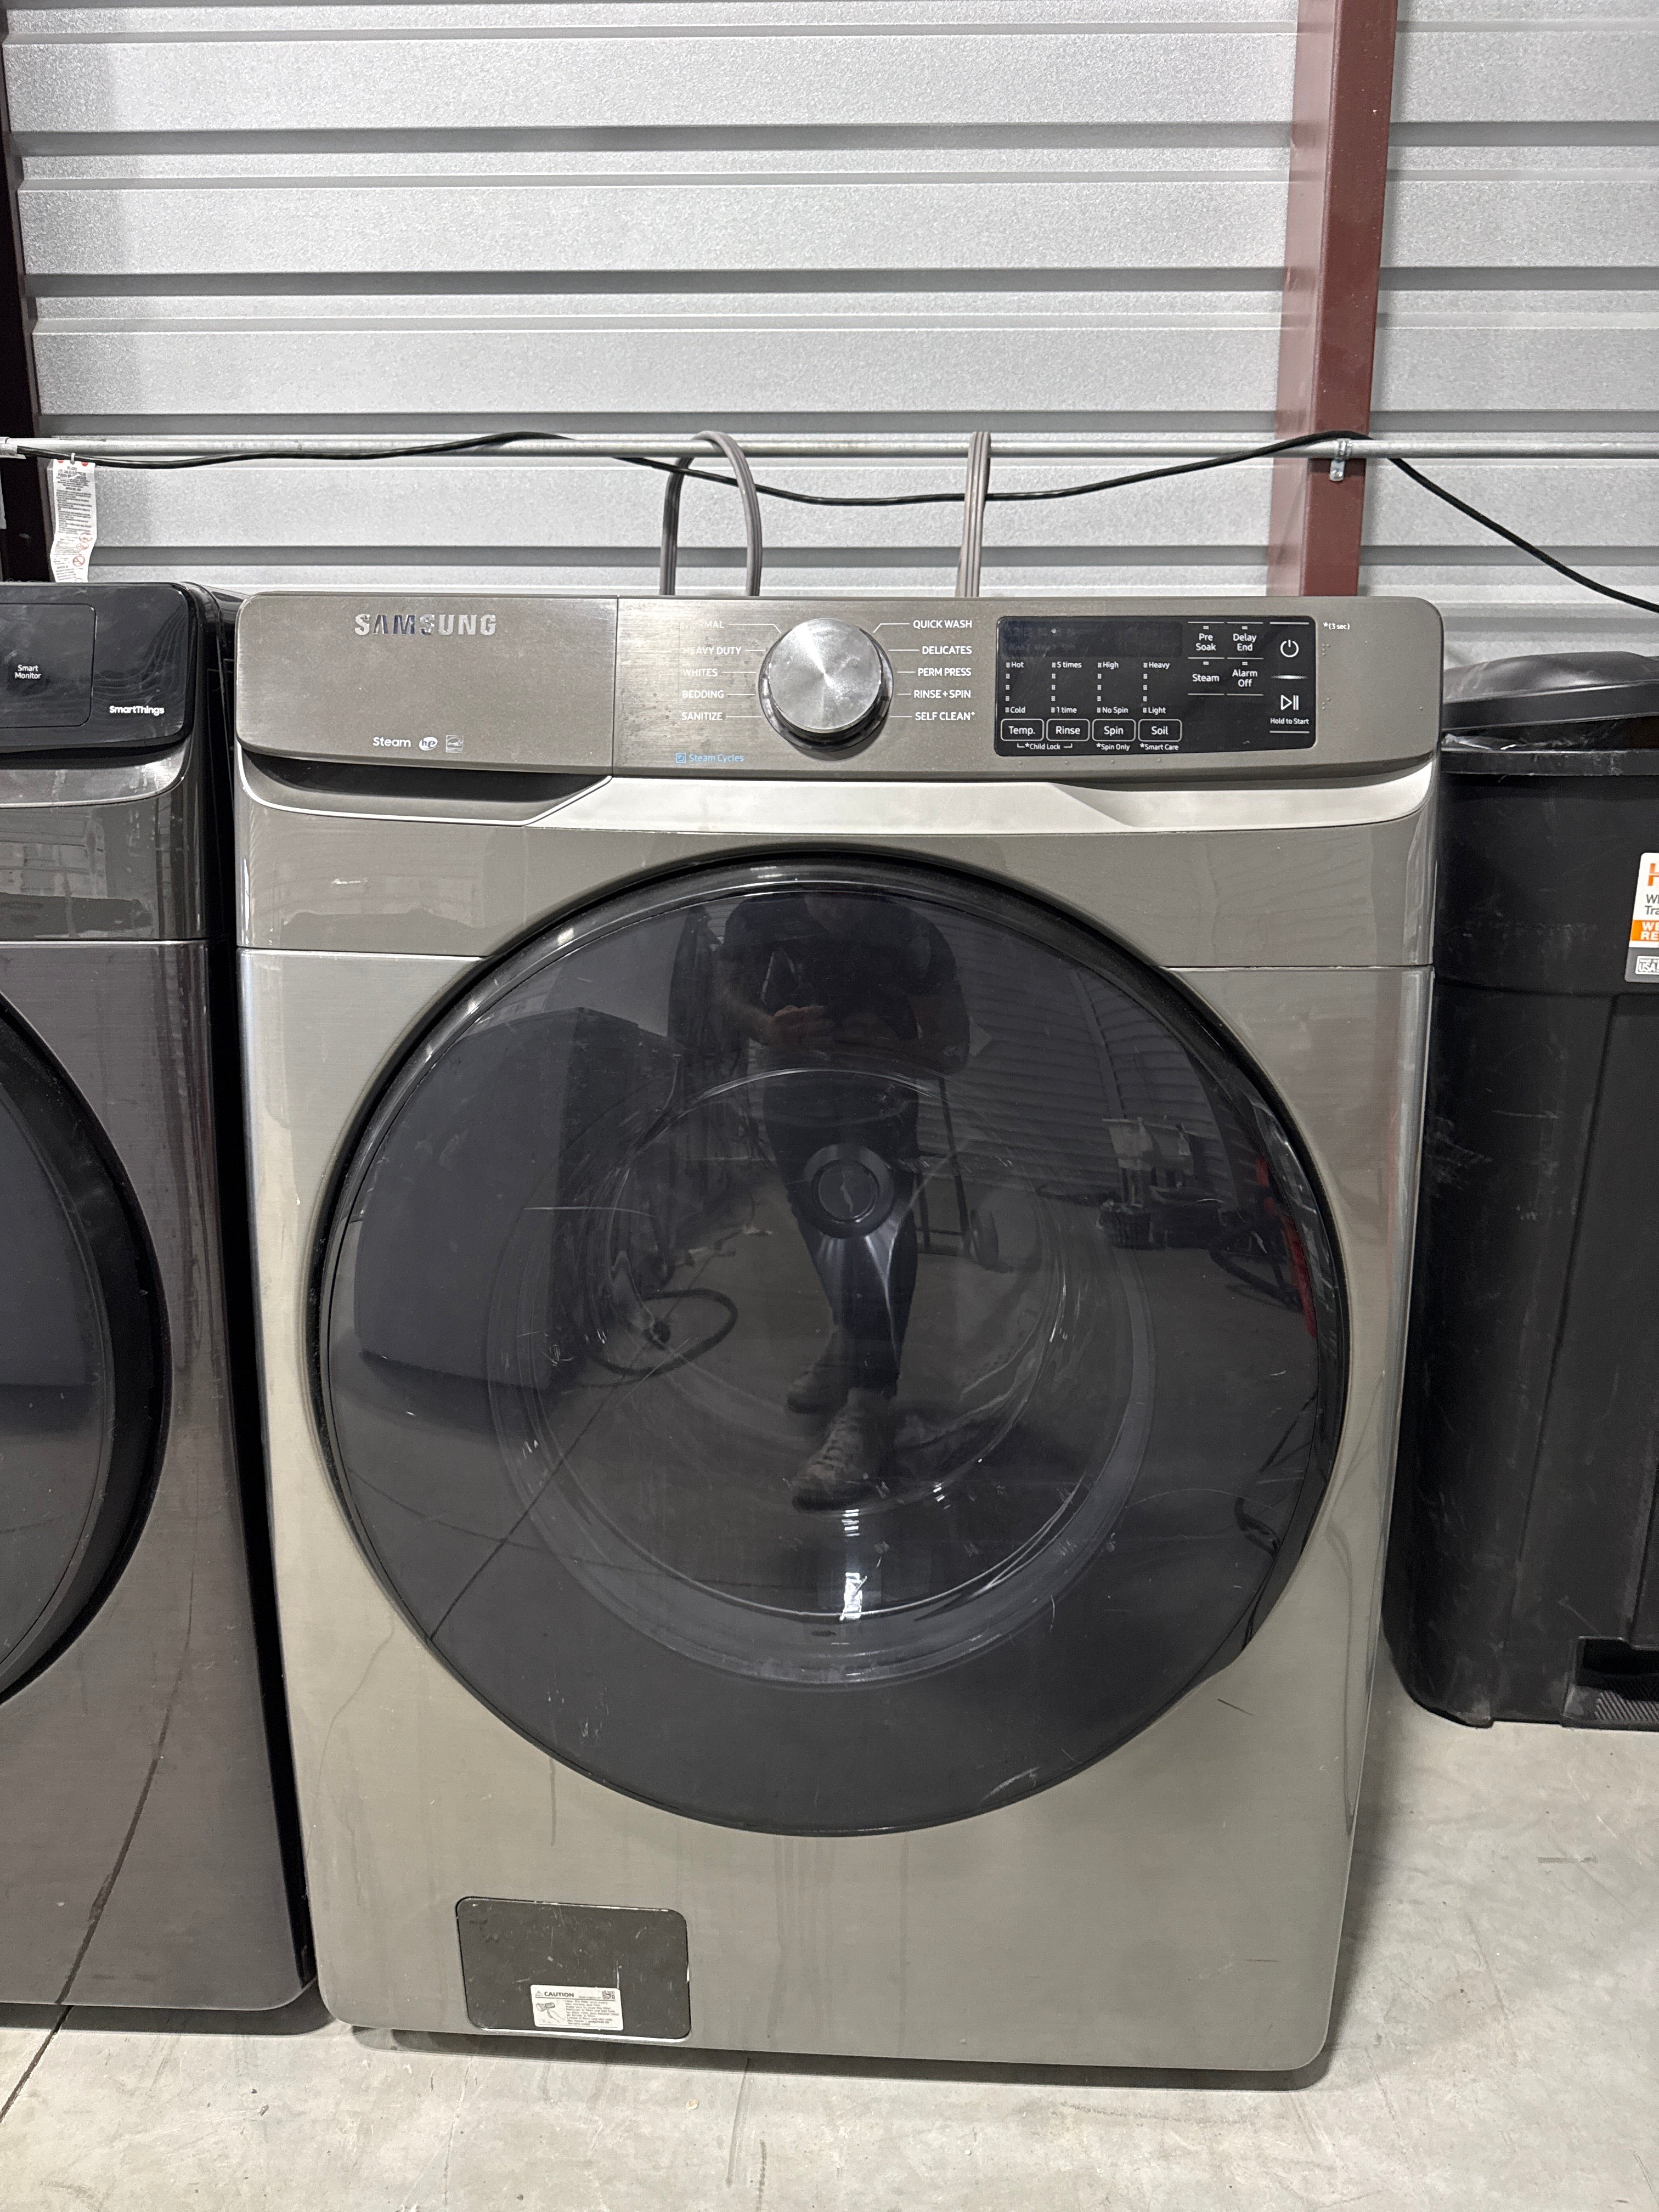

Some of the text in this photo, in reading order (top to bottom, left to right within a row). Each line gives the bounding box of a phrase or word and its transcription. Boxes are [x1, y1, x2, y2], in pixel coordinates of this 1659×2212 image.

[354, 614, 496, 635] SAMSUNG
[685, 620, 724, 629] RMAL
[913, 620, 972, 629] QUICK WASH
[1199, 633, 1213, 641] Pre
[1233, 633, 1257, 642] Delay
[716, 646, 742, 655] DUTY
[922, 646, 972, 654] DELICATES
[1237, 643, 1253, 651] End
[1103, 661, 1119, 670] High
[1148, 661, 1170, 670] Heavy
[683, 668, 718, 677] WHITES
[918, 668, 972, 676] PERM PRESS
[1232, 669, 1258, 677] Alarm
[1192, 673, 1220, 682] Steam
[1238, 679, 1252, 687] Off
[682, 690, 724, 698] BEDDING
[913, 690, 941, 698] RINSE
[949, 690, 971, 698] SPIN
[109, 706, 165, 716] SmartThings
[1113, 706, 1128, 715] Spin
[1148, 706, 1166, 715] Light
[681, 712, 723, 720] SANITIZE
[915, 712, 938, 720] SELF
[1008, 726, 1036, 736] Temp.
[1056, 726, 1081, 735] Rinse
[1104, 726, 1124, 736] Spin
[1151, 726, 1169, 735] Soil
[373, 737, 411, 747] Steam
[1115, 743, 1131, 752] Only
[689, 753, 744, 764] Steam Cycles
[1638, 963, 1656, 972] USA
